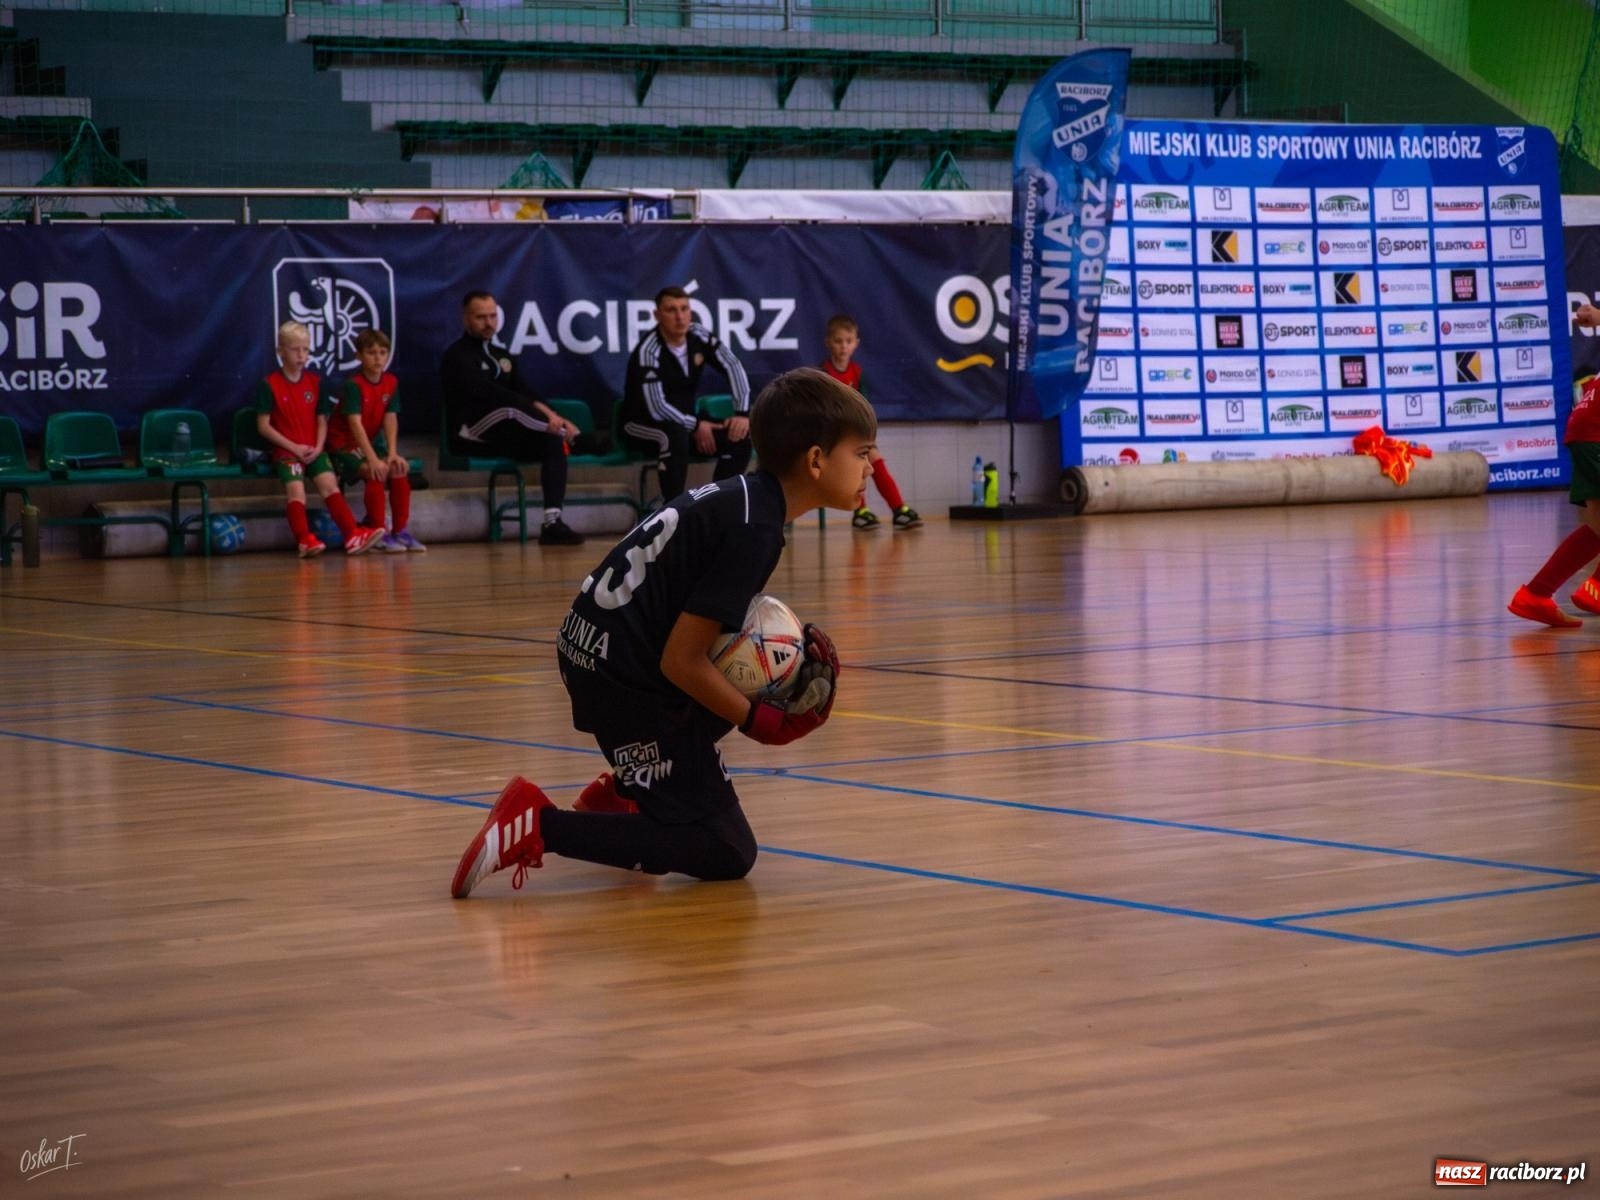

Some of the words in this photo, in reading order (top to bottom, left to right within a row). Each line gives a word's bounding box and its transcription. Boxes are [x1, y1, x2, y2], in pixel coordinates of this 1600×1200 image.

[1057, 113, 1102, 143] UNIA
[1129, 131, 1200, 157] MIEJSKI
[1207, 133, 1252, 158] KLUB
[1257, 135, 1349, 160] SPORTOWY
[1354, 136, 1396, 159] UNIA
[1400, 131, 1482, 159] RACIBÓRZ
[1023, 176, 1038, 260] SPORTOWY
[1137, 240, 1161, 250] BOXY
[1394, 240, 1428, 252] SPORT
[1020, 264, 1033, 305] KLUB
[1037, 212, 1074, 337] UNIA
[1074, 177, 1107, 373] RACIBÓRZ
[1155, 284, 1192, 295] SPORT
[1263, 284, 1287, 294] BOXY
[1017, 309, 1030, 371] MIEJSKI
[1280, 326, 1317, 337] SPORT
[1387, 365, 1409, 375] BOXY
[1517, 438, 1555, 450] Racibórz
